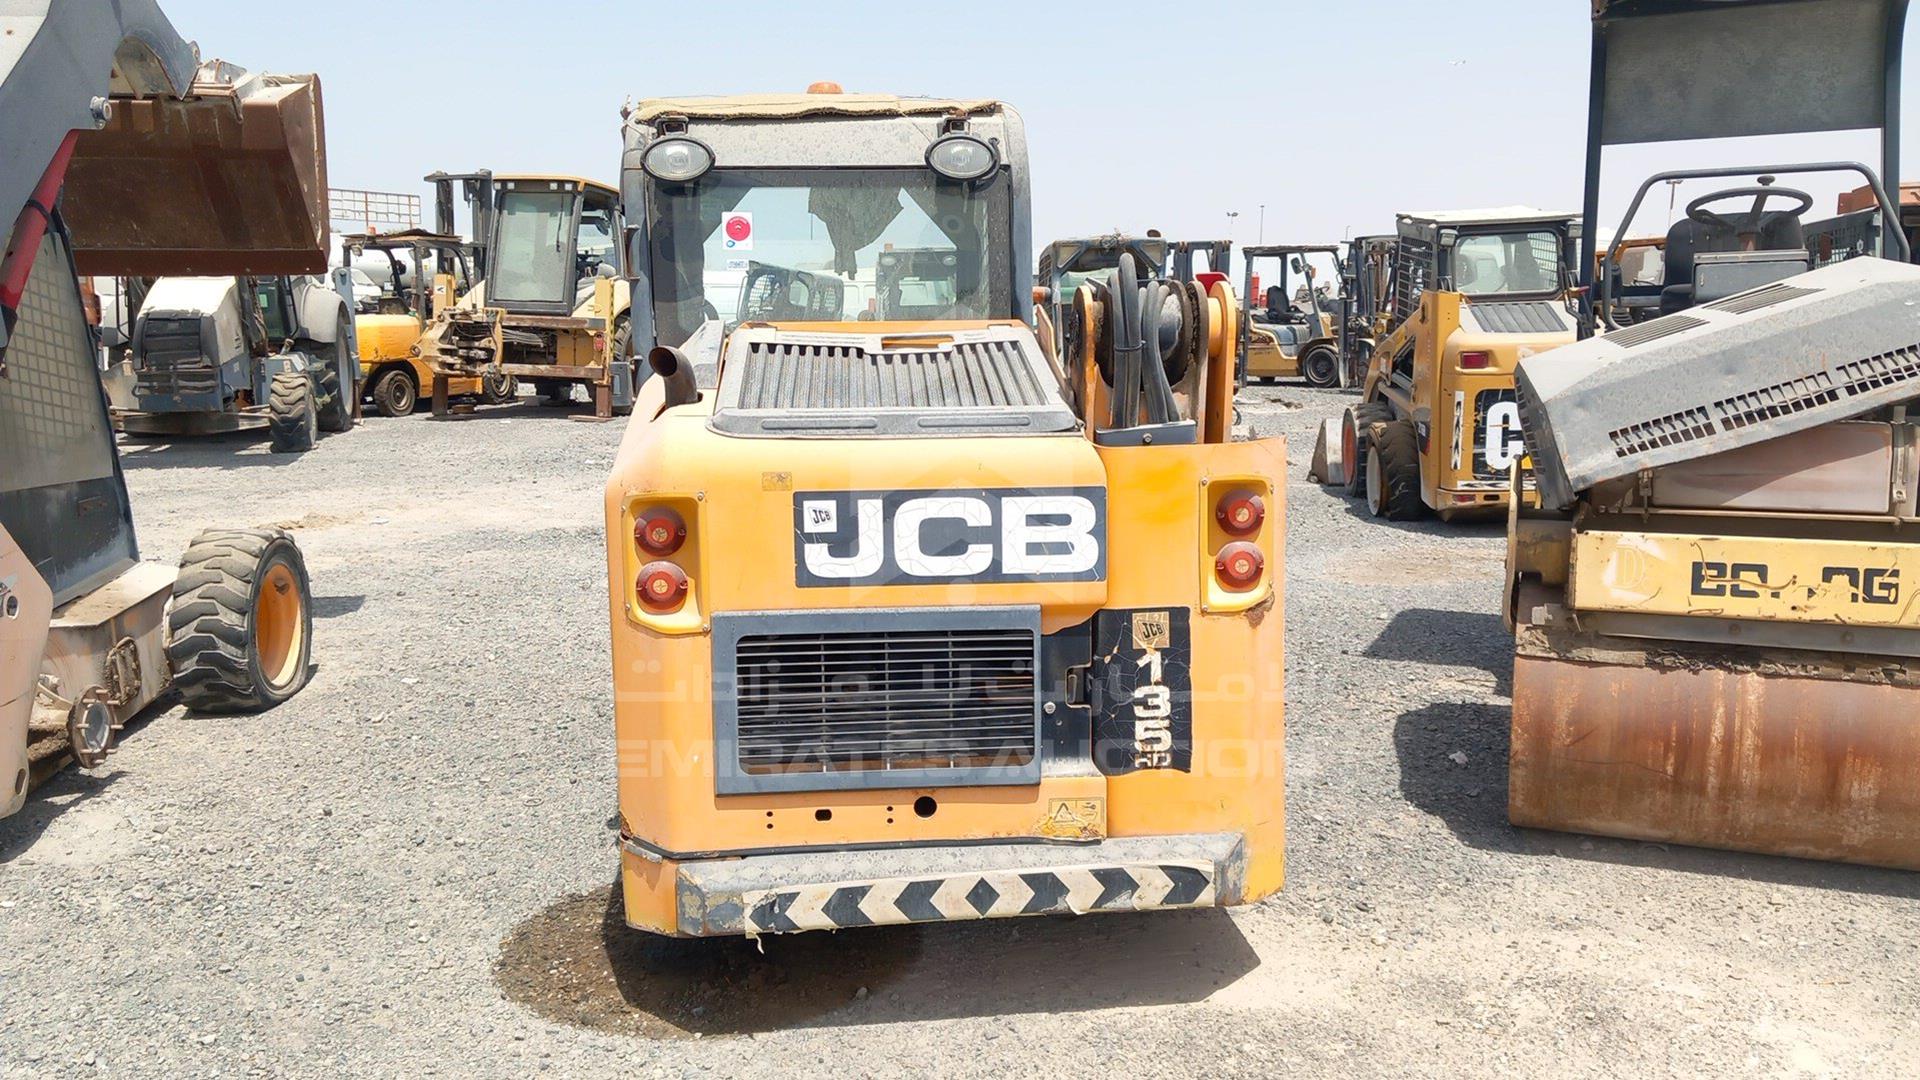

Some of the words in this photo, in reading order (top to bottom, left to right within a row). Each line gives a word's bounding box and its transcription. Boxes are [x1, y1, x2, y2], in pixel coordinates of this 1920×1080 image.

[804, 496, 1099, 578] JCB
[812, 509, 831, 524] JCB
[1142, 622, 1164, 639] JCB
[1134, 651, 1172, 752] 135
